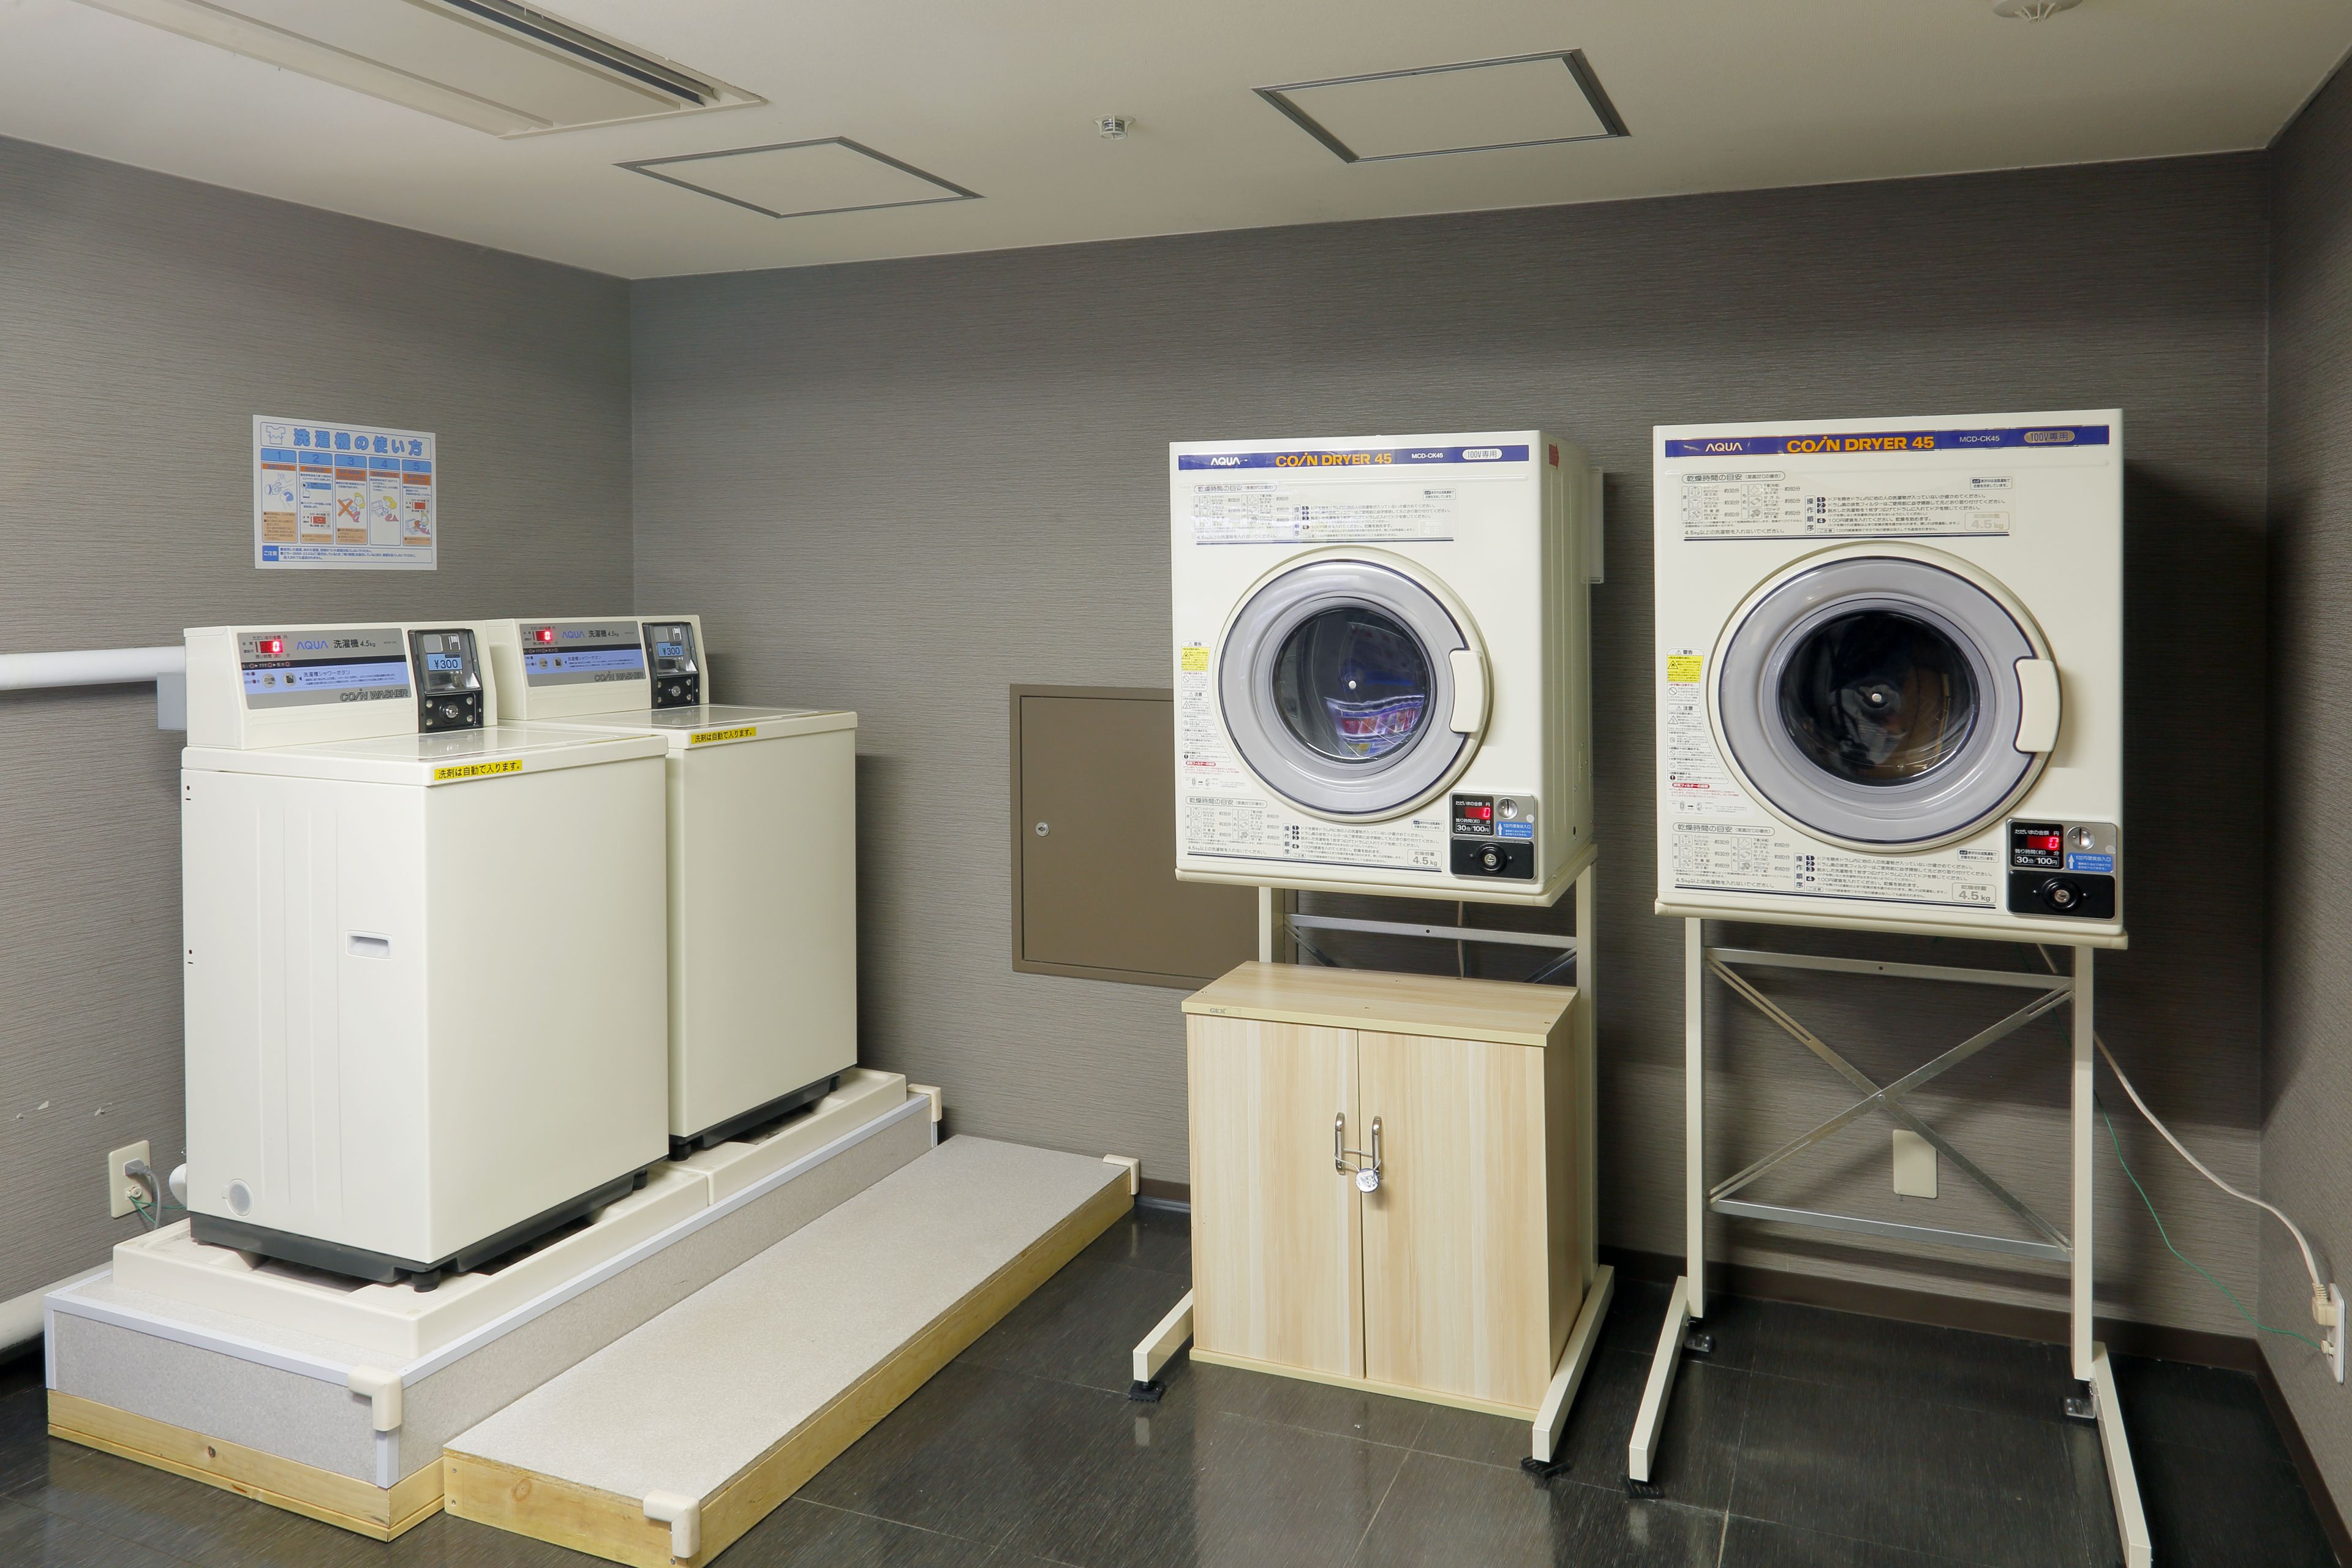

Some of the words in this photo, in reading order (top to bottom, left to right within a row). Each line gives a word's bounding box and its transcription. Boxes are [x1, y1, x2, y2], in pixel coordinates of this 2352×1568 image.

[2030, 432, 2068, 441] 100V専用
[293, 428, 423, 456] 洗濯機の使い方
[1705, 442, 1743, 452] AQUA
[1845, 437, 1907, 451] DRYER
[1912, 435, 1934, 448] 45
[277, 451, 282, 461] 1
[313, 454, 319, 462] 2
[1210, 457, 1241, 466] AQUA
[1322, 453, 1370, 466] DRYER
[1374, 453, 1392, 464] 45
[347, 457, 354, 466] 3
[545, 631, 550, 640] 0
[273, 641, 279, 652] 0
[296, 641, 328, 650] AQUA
[333, 639, 359, 648] 洗濯機
[434, 660, 458, 669] ¥300
[370, 689, 408, 699] WASHER
[695, 729, 753, 744] 洗剤は自動で入ります。
[438, 761, 520, 780] 洗剤は自動で入ります。
[1483, 808, 1490, 818] 0
[2048, 837, 2059, 848] 0
[1188, 846, 1267, 854] 4.5kg以上の洗濯物を入れないでください。
[1676, 878, 1774, 888] 4.5kg以上の洗濯物を入れないでください。
[1959, 891, 1979, 900] 4.5
